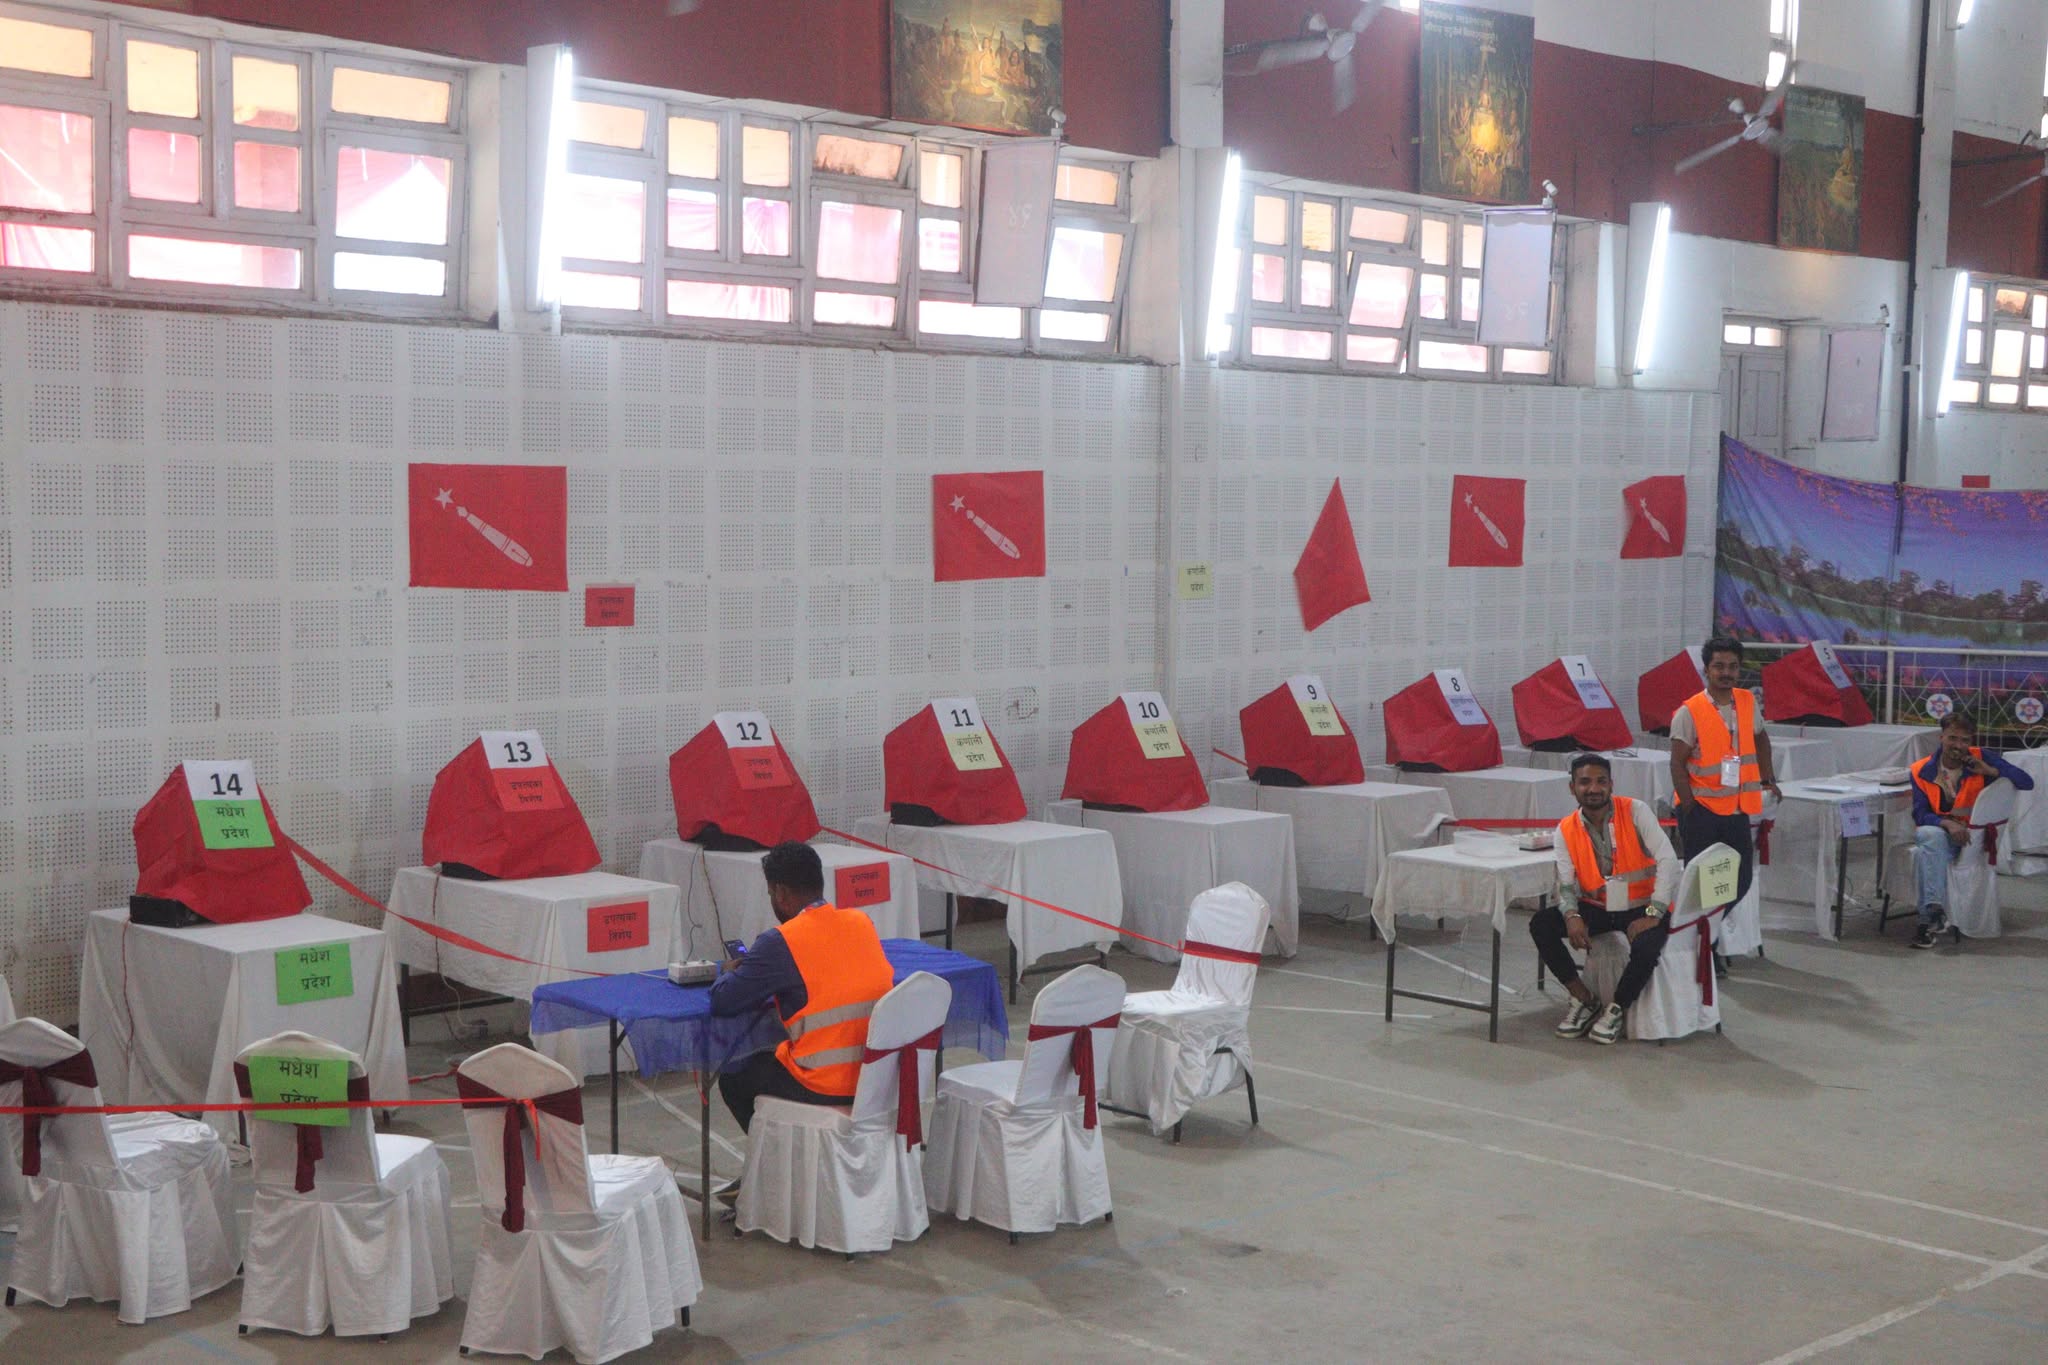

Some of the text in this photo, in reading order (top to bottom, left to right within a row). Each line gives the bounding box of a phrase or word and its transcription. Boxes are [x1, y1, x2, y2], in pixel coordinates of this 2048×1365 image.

[1577, 662, 1585, 676] 7
[1307, 684, 1317, 700] 9
[1450, 677, 1460, 692] 8
[950, 708, 974, 728] 11
[1138, 701, 1160, 719] 10
[736, 721, 762, 741] 12
[503, 741, 532, 763] 13
[210, 772, 243, 796] 14
[215, 803, 246, 817] मधेश
[221, 825, 249, 839] प्रदेश
[300, 948, 330, 965] मधेश
[301, 974, 331, 990] प्रदेश
[279, 1057, 320, 1079] मधेश
